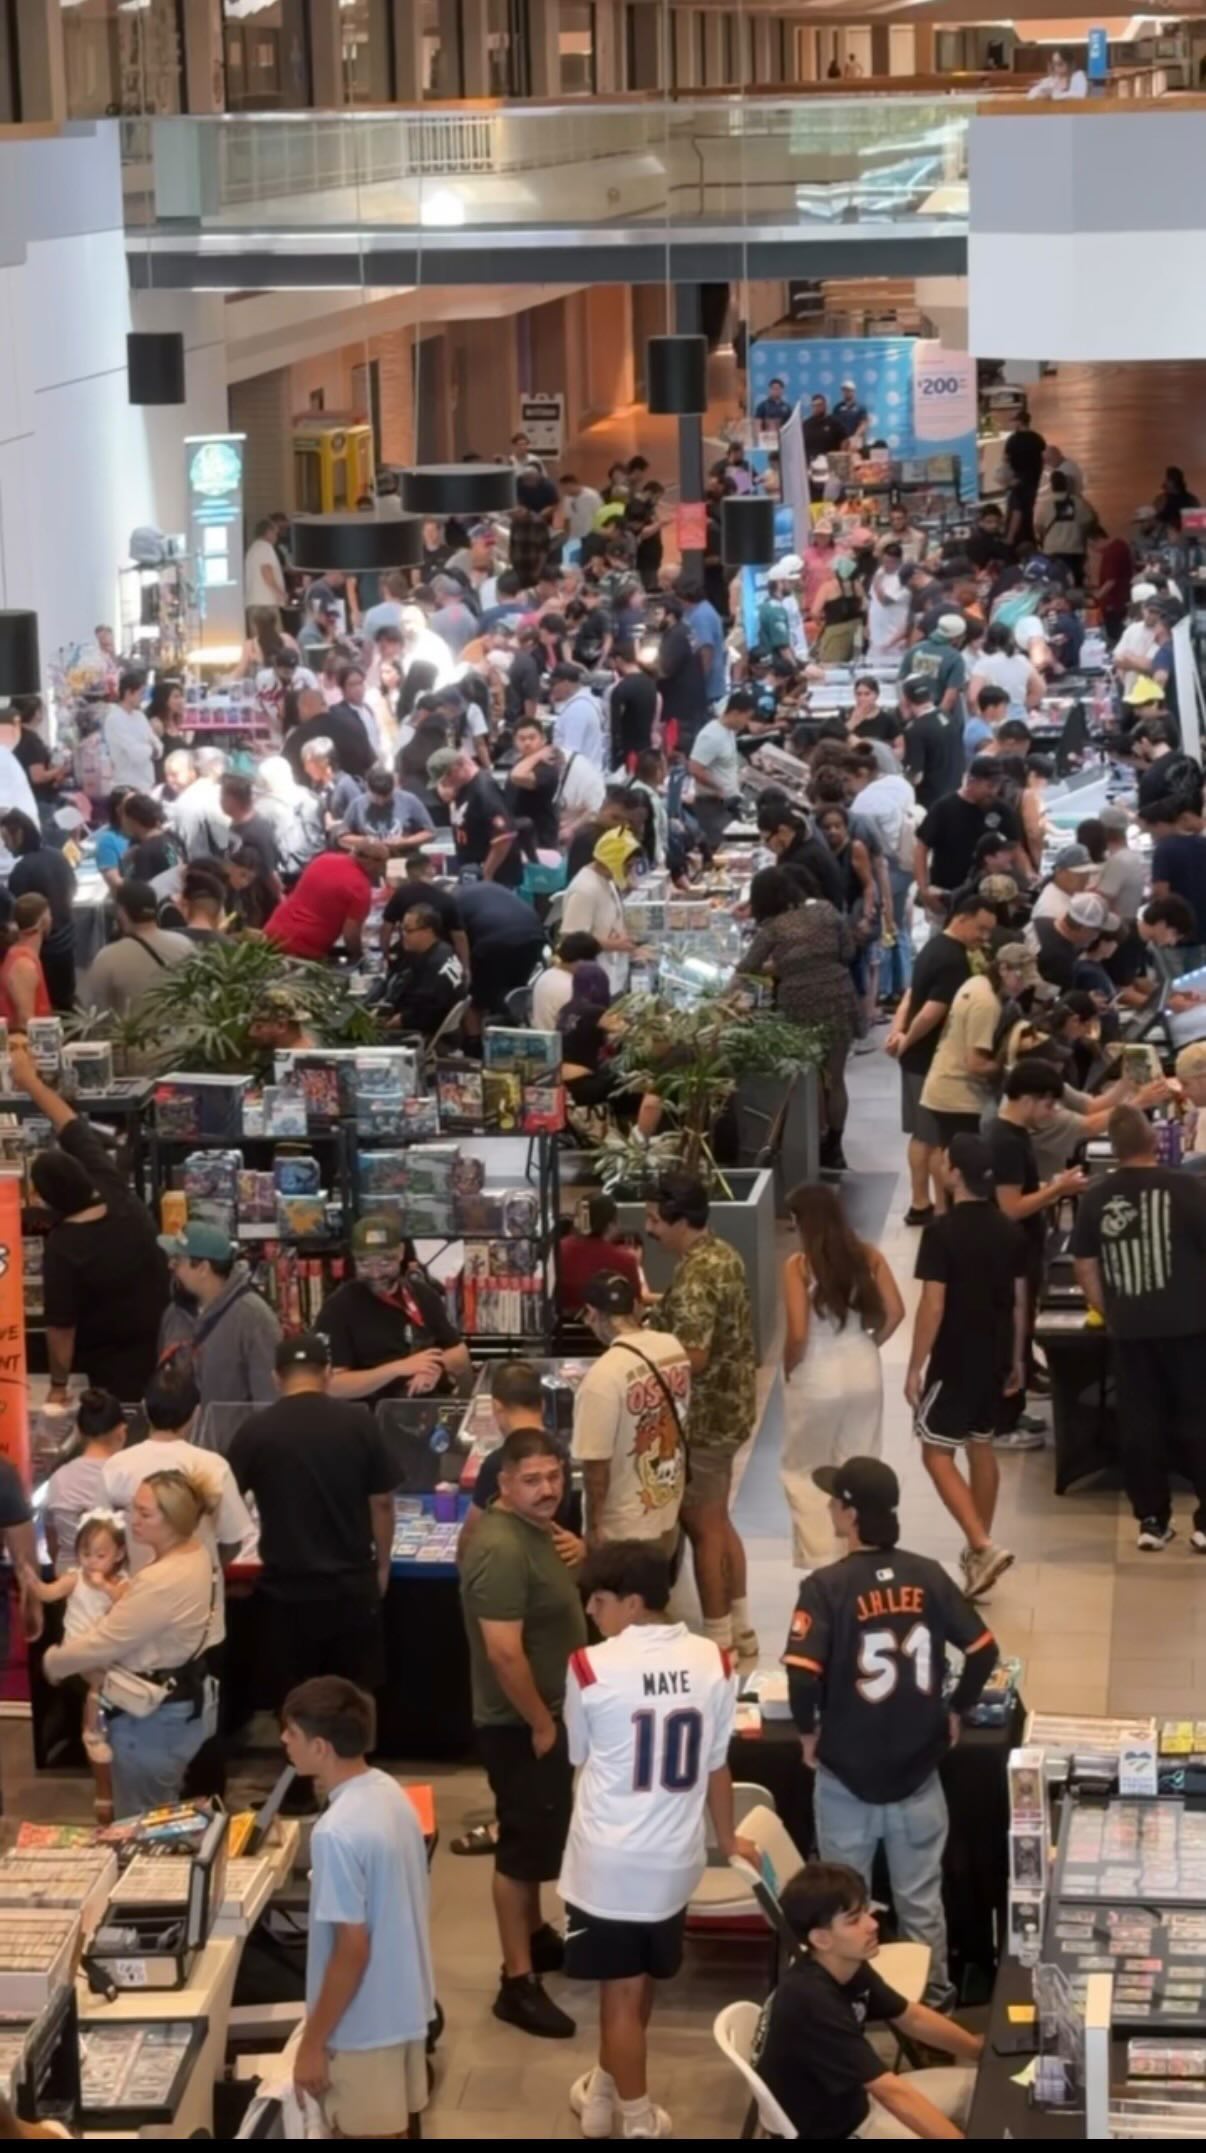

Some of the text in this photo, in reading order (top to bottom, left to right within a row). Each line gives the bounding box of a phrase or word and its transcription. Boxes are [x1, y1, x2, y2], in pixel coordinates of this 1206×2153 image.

[642, 1670, 691, 1696] MAYE
[857, 1621, 932, 1703] 51
[631, 1707, 703, 1792] 10
